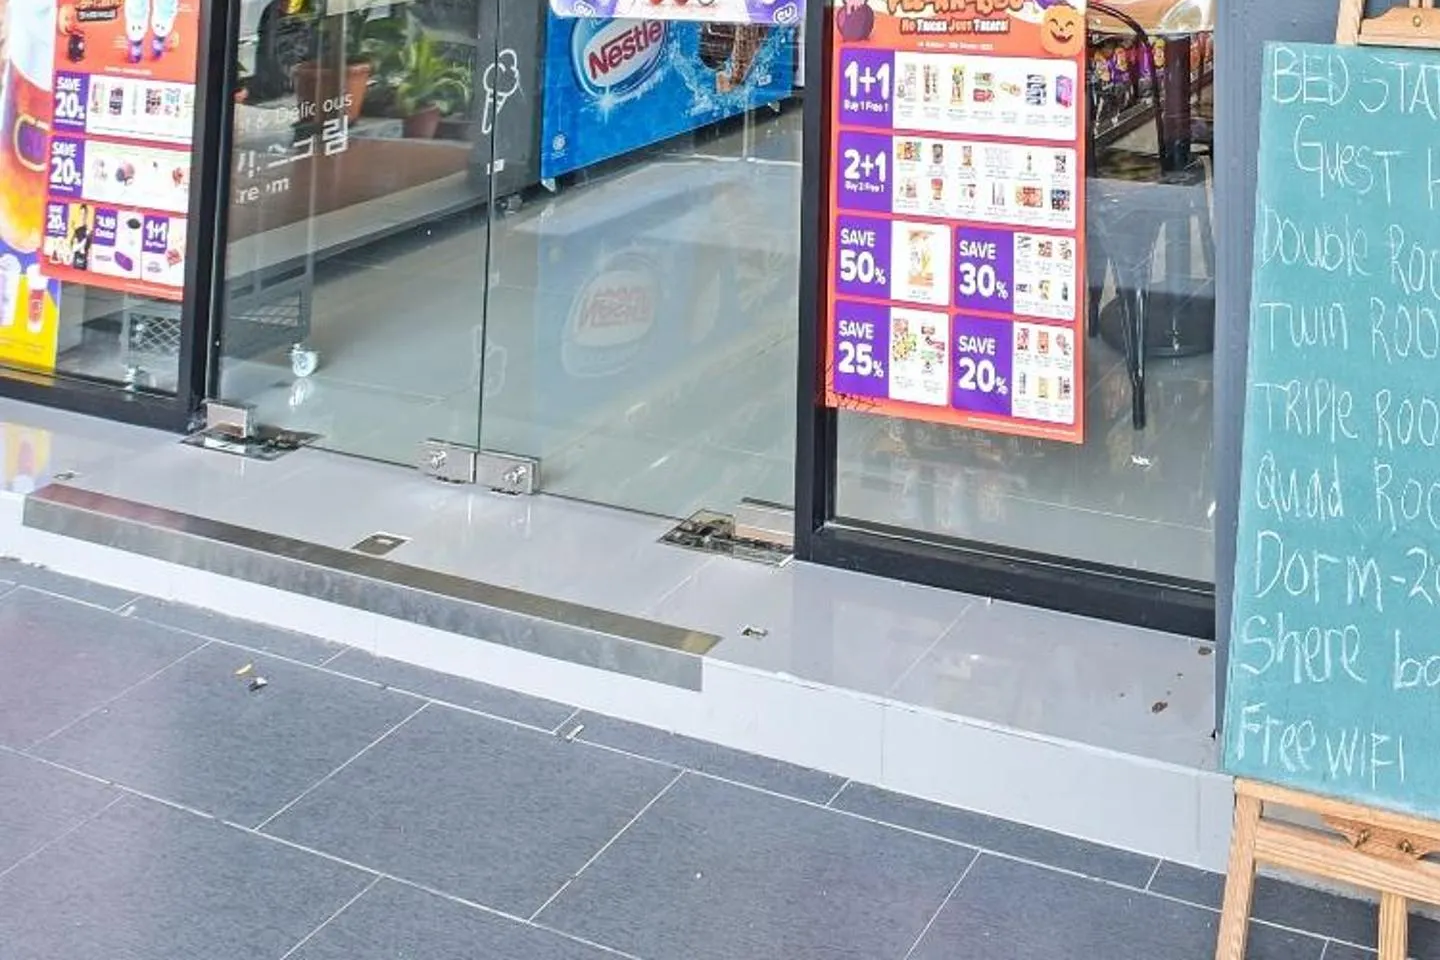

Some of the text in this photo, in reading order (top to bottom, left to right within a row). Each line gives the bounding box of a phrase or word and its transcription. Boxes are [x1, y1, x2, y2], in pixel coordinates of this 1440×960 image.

[56, 75, 82, 92] SAVE
[844, 60, 890, 99] 1+1
[1272, 46, 1349, 105] BED
[55, 91, 85, 121] 20%
[51, 141, 78, 158] SAVE
[50, 157, 82, 186] 20%
[843, 148, 887, 182] 2+1
[145, 219, 168, 241] 1+1
[840, 228, 876, 248] SAVE
[959, 240, 996, 260] SAVE
[839, 250, 886, 285] 50%
[958, 263, 1008, 300] 30%
[838, 320, 875, 340] SAVE
[837, 341, 884, 378] 25%
[958, 335, 996, 356] SAVE
[957, 357, 1008, 396] 20%
